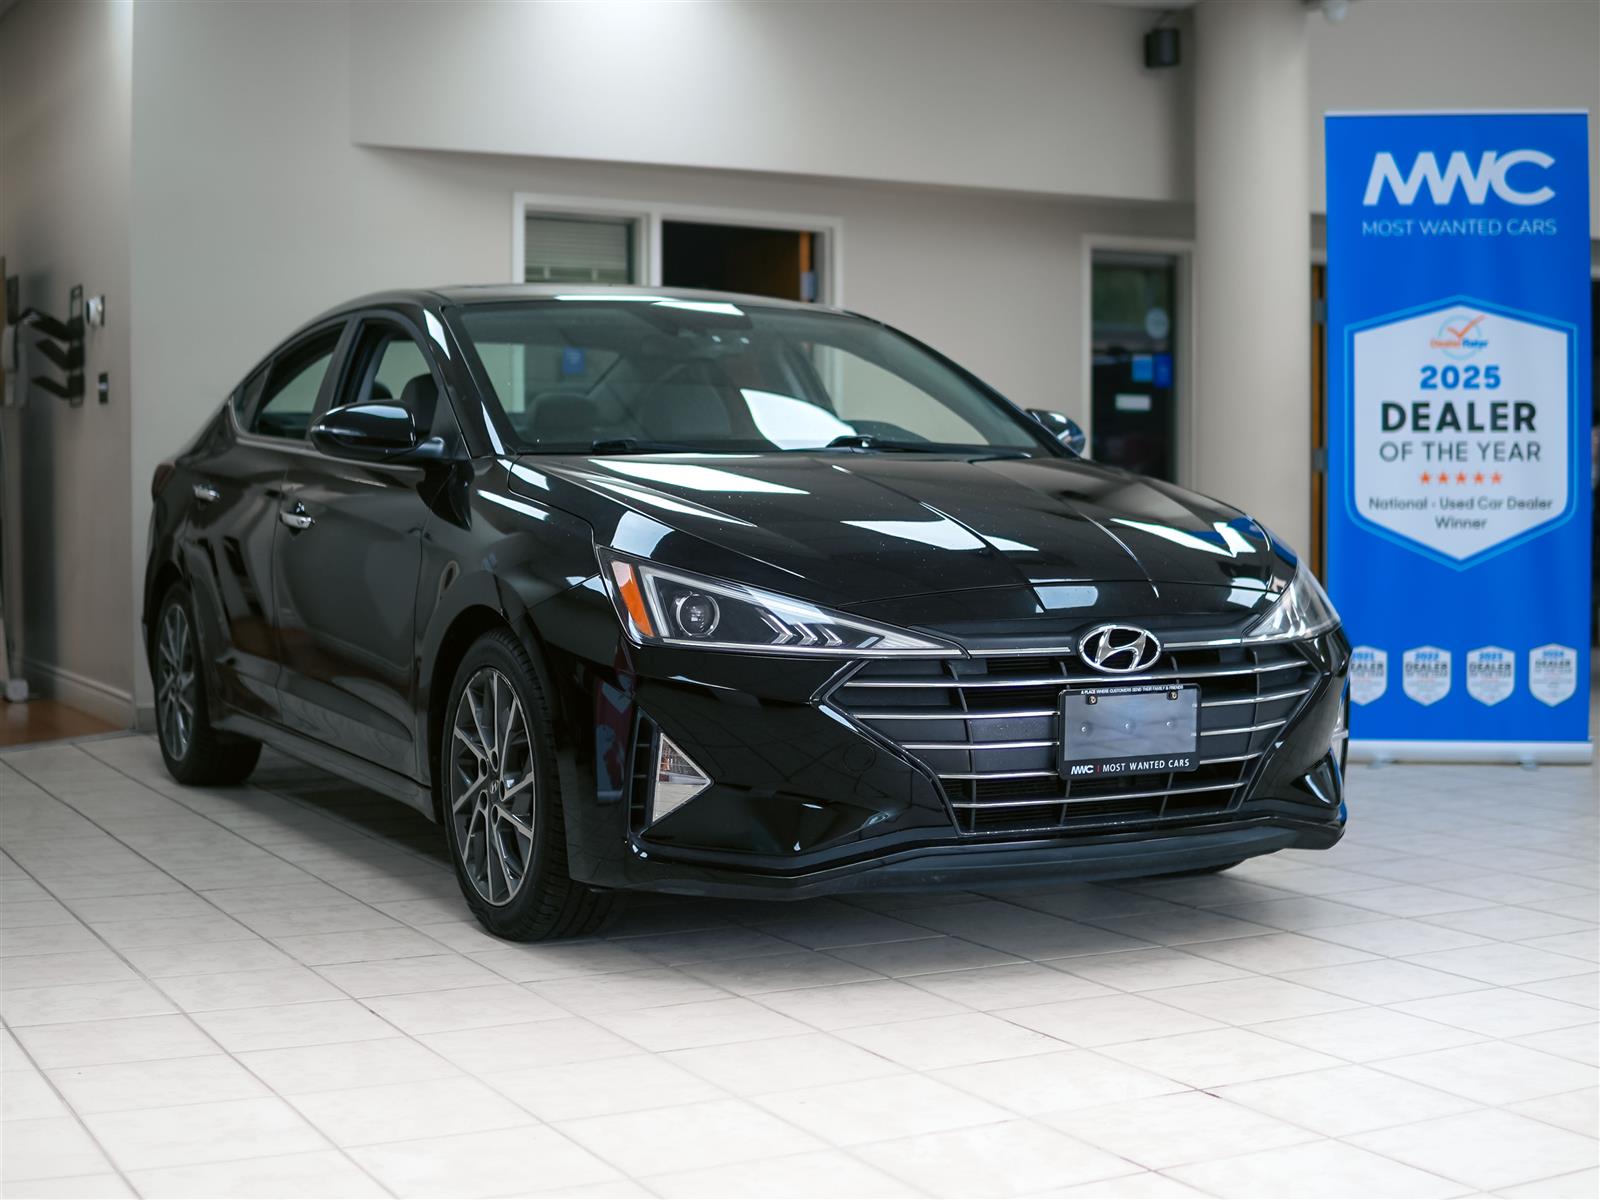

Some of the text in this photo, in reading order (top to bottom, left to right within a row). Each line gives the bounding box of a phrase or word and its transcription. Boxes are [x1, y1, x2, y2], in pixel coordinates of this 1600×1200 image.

[1362, 149, 1555, 205] MWC
[1362, 218, 1557, 237] MOST WANTED CARS
[1420, 365, 1501, 390] 2025
[1381, 401, 1537, 432] DEALER
[1379, 441, 1541, 462] OF THE YEAR
[1369, 496, 1428, 511] National
[1439, 496, 1474, 511] Used
[1478, 496, 1503, 511] Car
[1507, 496, 1553, 511] Dealer
[1435, 516, 1488, 531] Winner
[1351, 663, 1384, 673] EALER
[1102, 764, 1126, 773] MOST
[1129, 761, 1165, 771] WANTED
[1168, 758, 1190, 767] CARS
